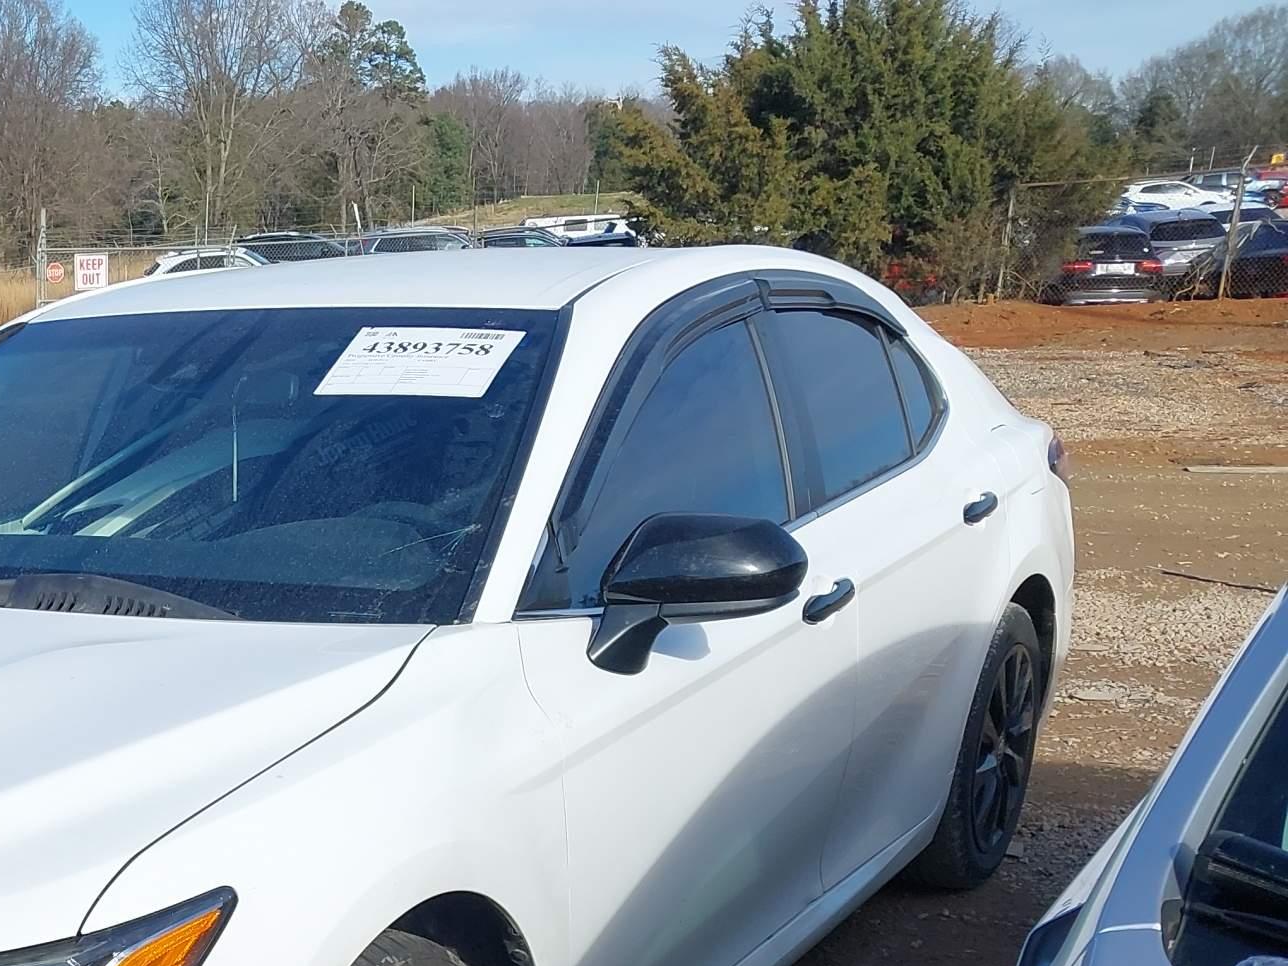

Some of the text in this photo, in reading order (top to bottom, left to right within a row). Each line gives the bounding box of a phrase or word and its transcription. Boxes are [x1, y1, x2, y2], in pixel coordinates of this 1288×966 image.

[79, 258, 104, 271] KEEP
[48, 269, 63, 277] STOP
[82, 273, 101, 286] OUT
[362, 341, 495, 356] 43893758
